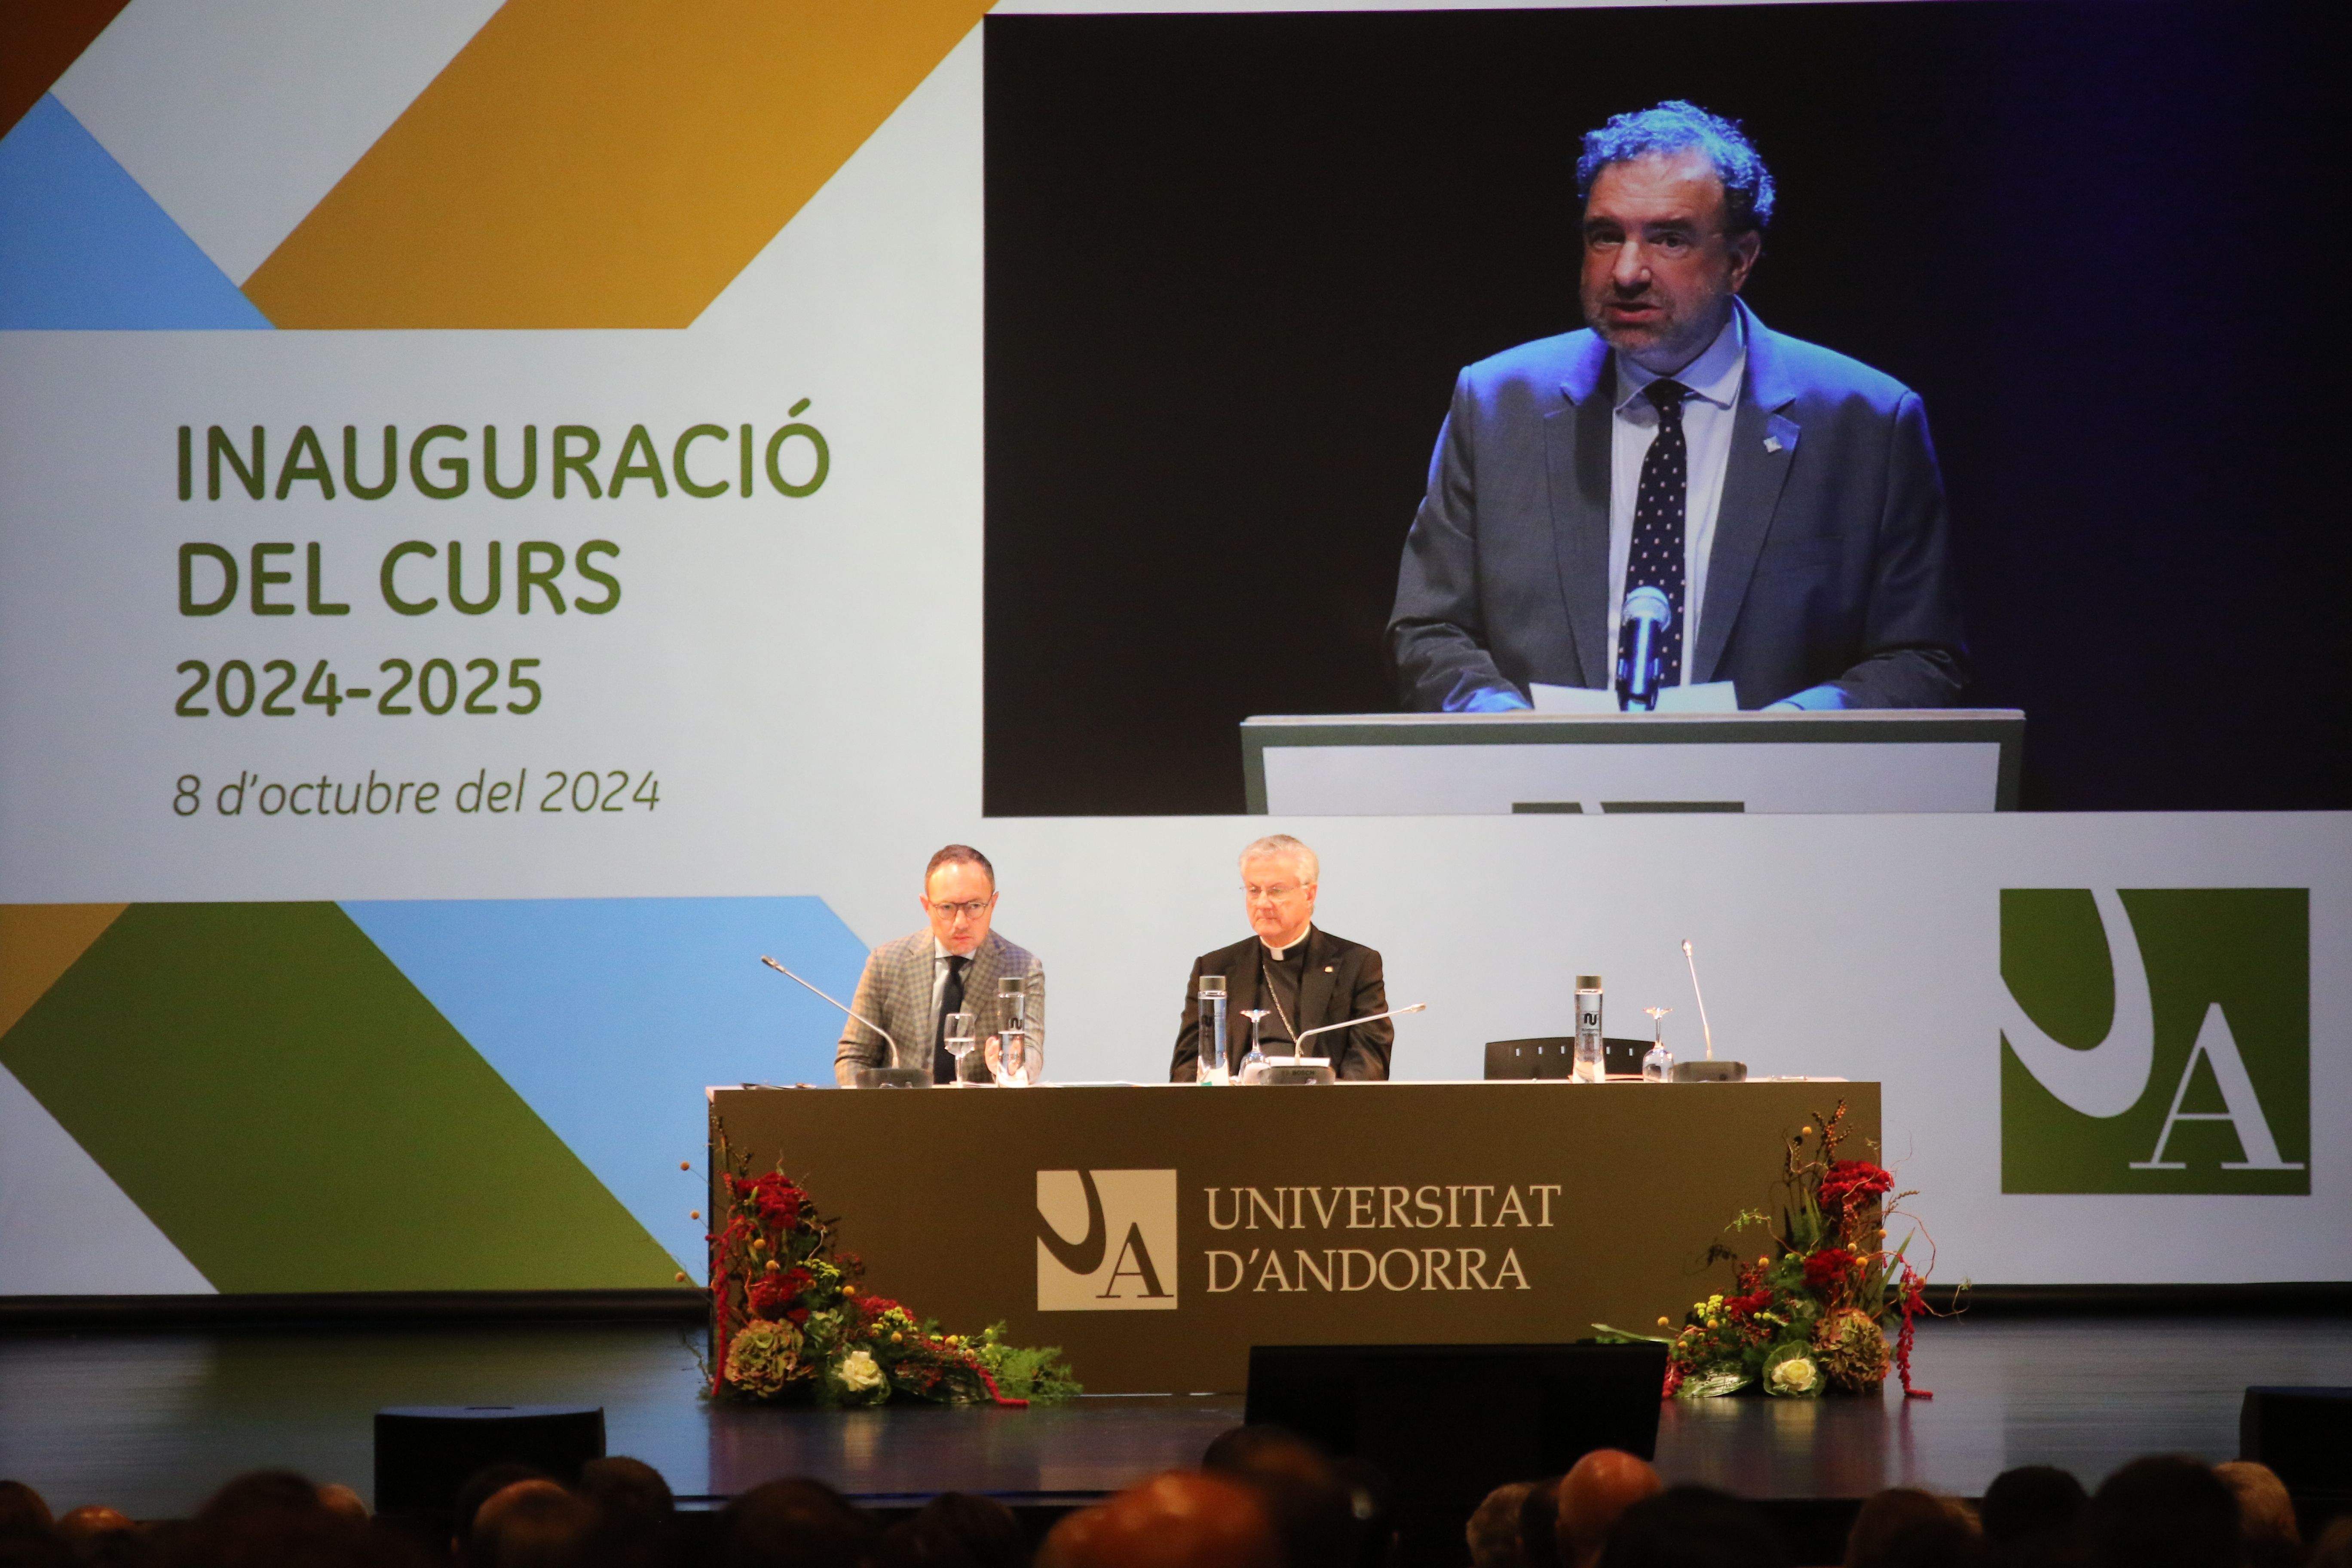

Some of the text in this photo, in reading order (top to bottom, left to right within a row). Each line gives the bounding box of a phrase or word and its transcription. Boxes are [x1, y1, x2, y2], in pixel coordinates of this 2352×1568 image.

[177, 398, 830, 502] INAUGURACIÓ
[178, 539, 622, 617] DEL CURS
[175, 658, 542, 718] 2024-2025
[172, 767, 660, 817] 8 d’octubre del 2024
[1204, 1184, 1562, 1230] UNIVERSITAT
[1204, 1247, 1531, 1292] D’ANDORRA
